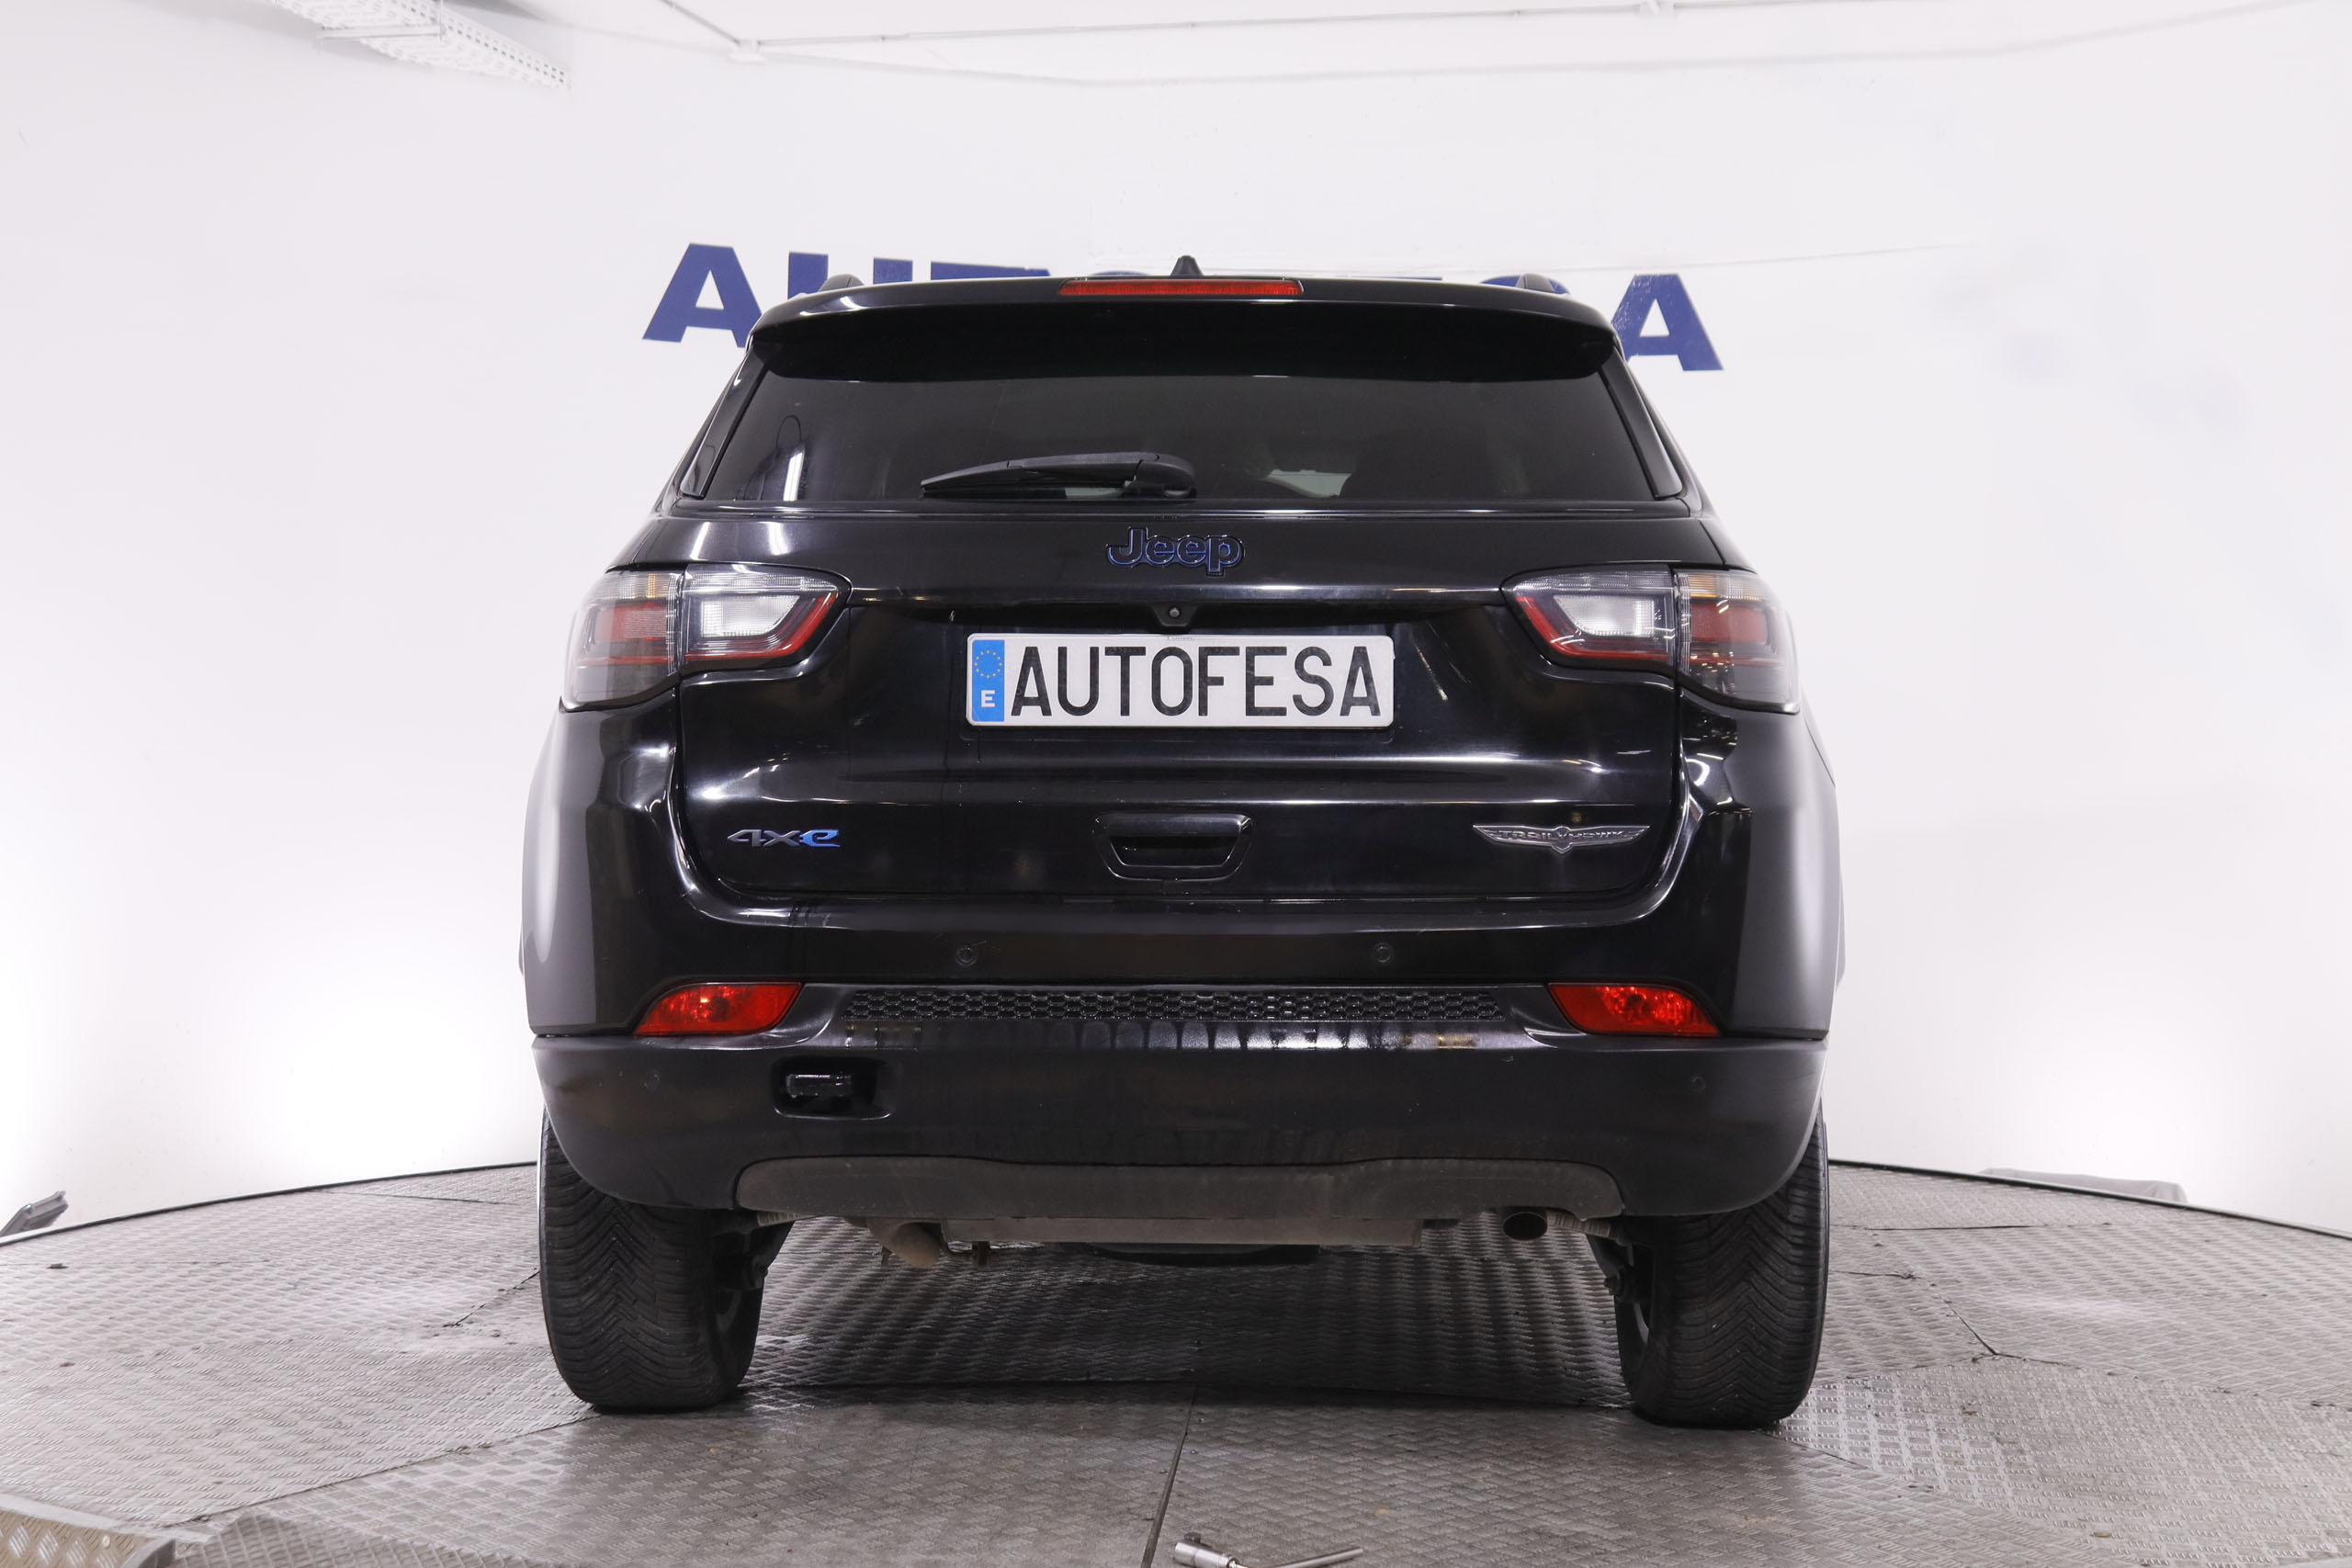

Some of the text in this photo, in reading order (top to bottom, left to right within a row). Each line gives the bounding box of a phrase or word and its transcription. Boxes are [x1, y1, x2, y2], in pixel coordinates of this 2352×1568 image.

[1105, 526, 1244, 575] Jeep
[979, 689, 996, 707] E
[1011, 646, 1381, 716] AUTOFESA
